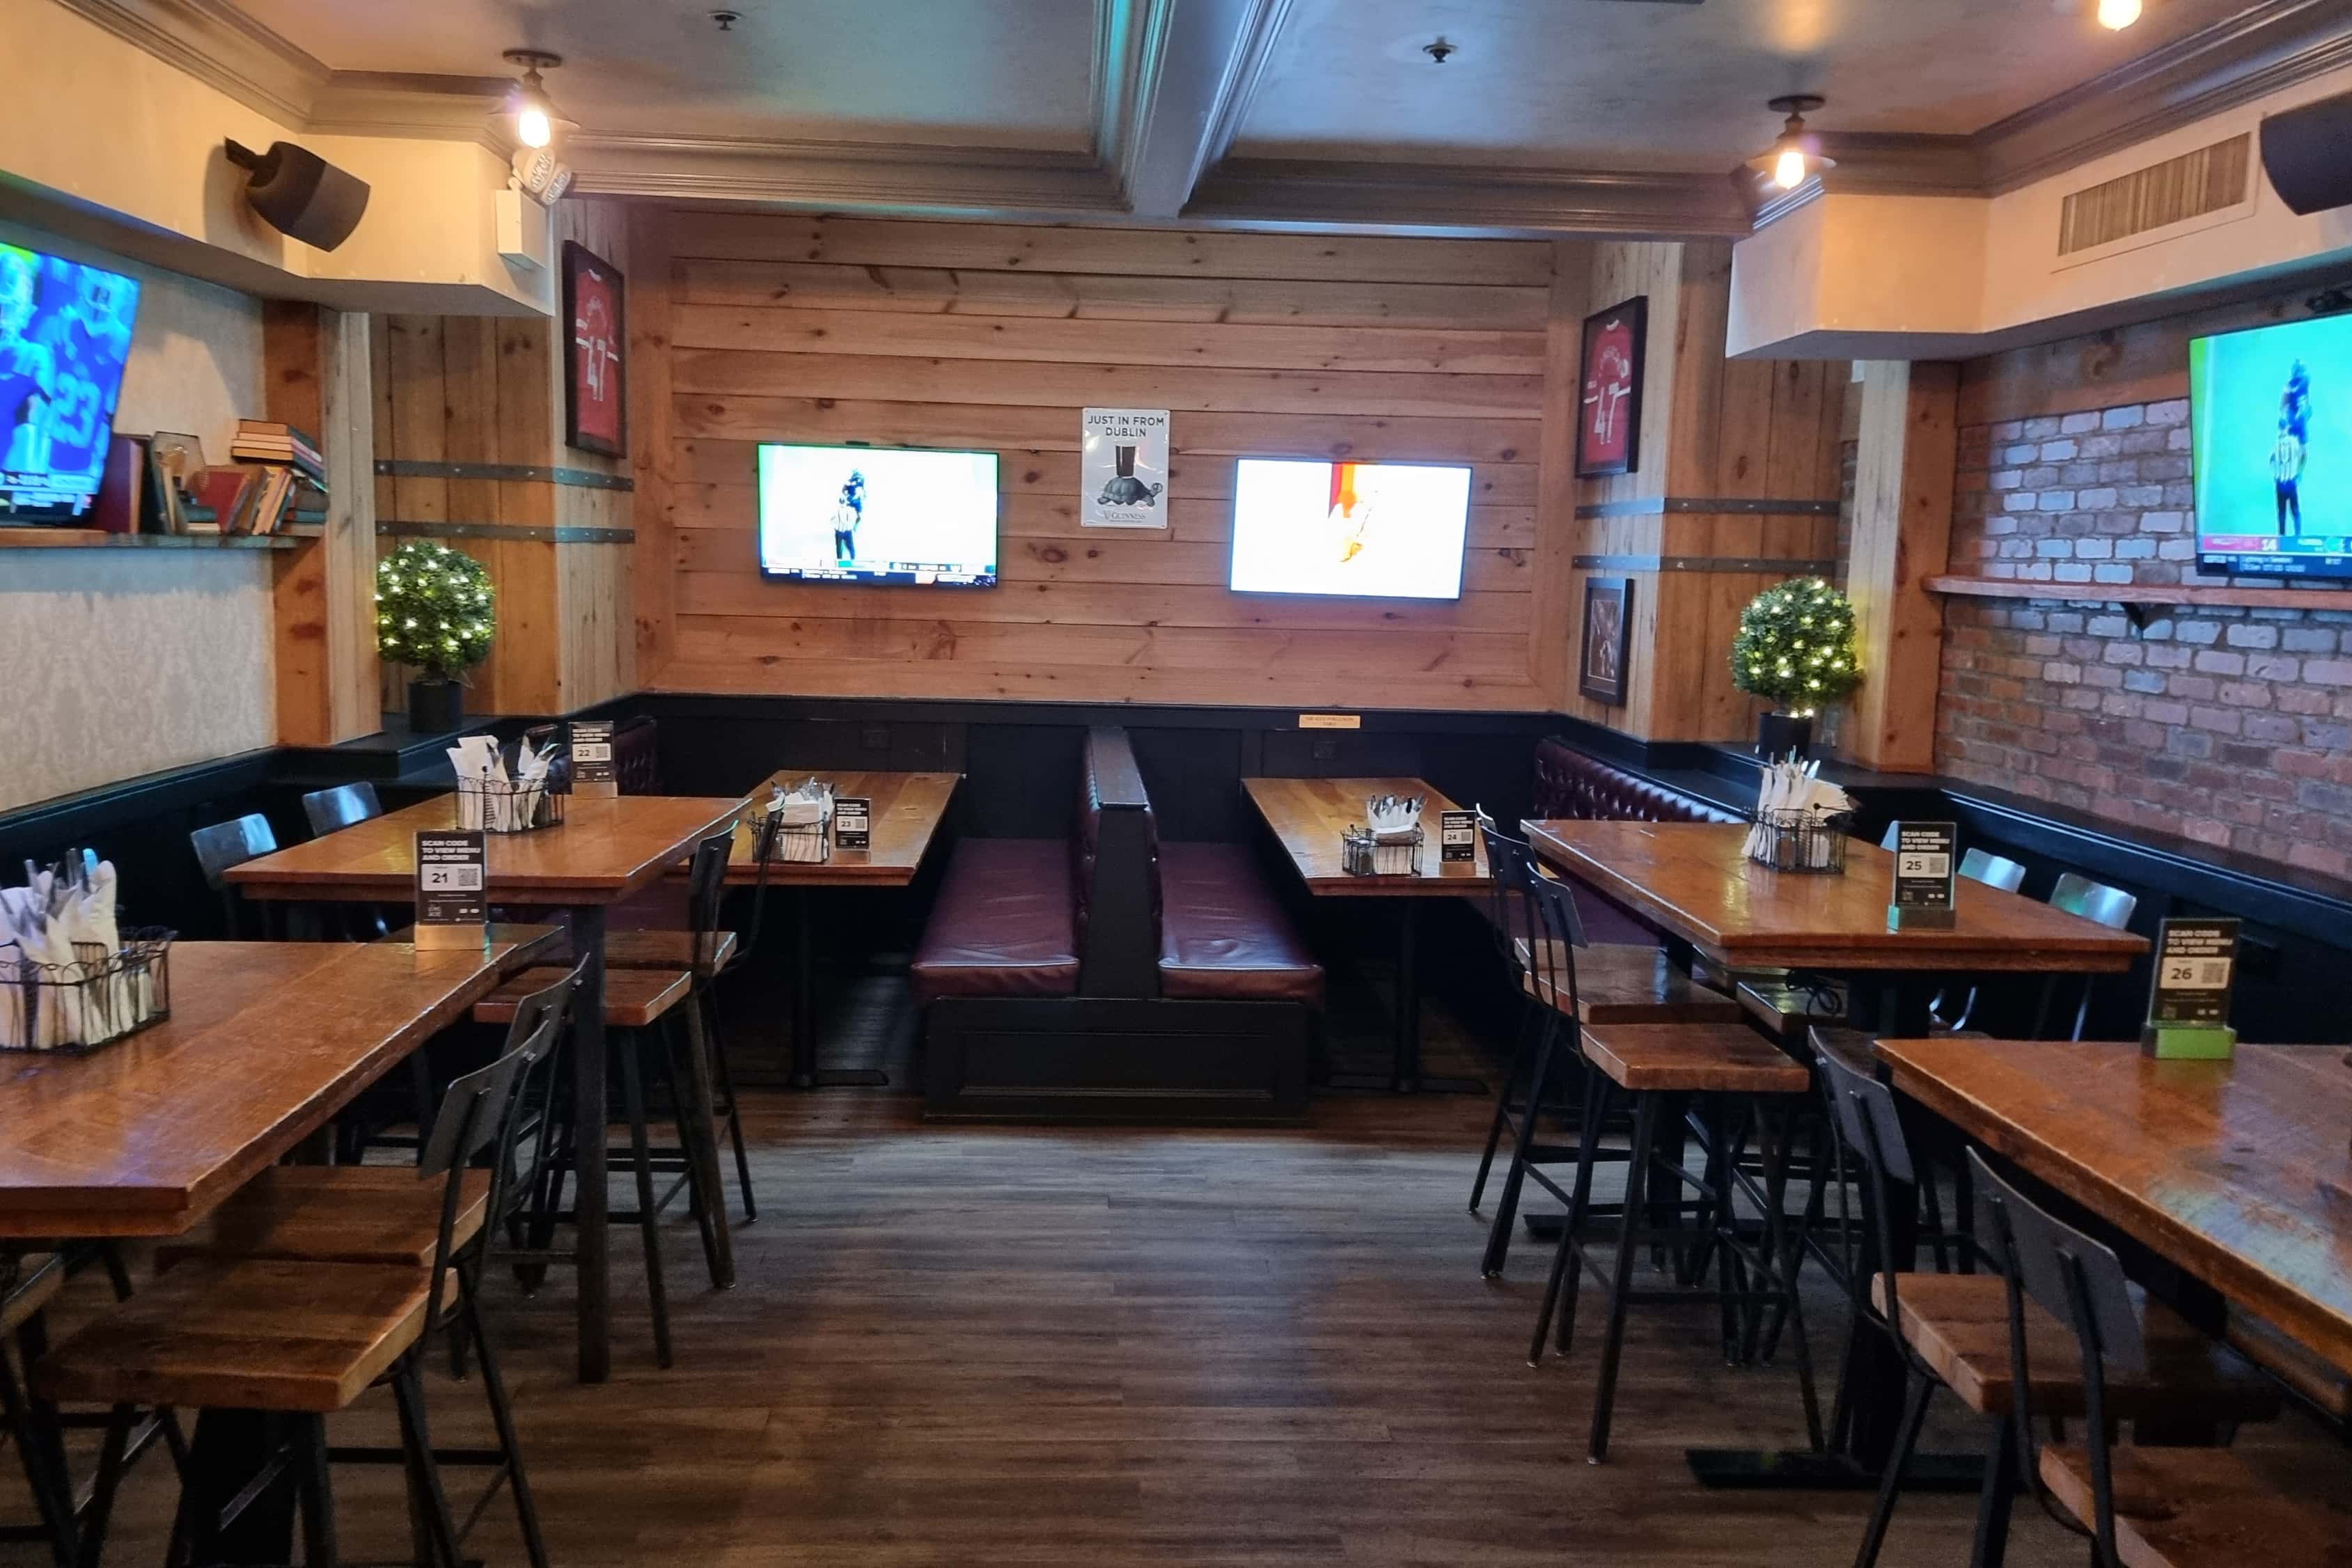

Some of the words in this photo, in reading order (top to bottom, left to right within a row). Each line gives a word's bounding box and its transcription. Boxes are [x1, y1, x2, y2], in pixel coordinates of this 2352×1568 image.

[1088, 416, 1115, 425] JUST
[1118, 416, 1129, 425] IN
[1133, 416, 1164, 427] FROM
[1106, 427, 1147, 437] DUBLIN
[1906, 861, 1922, 870] 25
[431, 872, 448, 884] 21
[2170, 967, 2193, 980] 26
